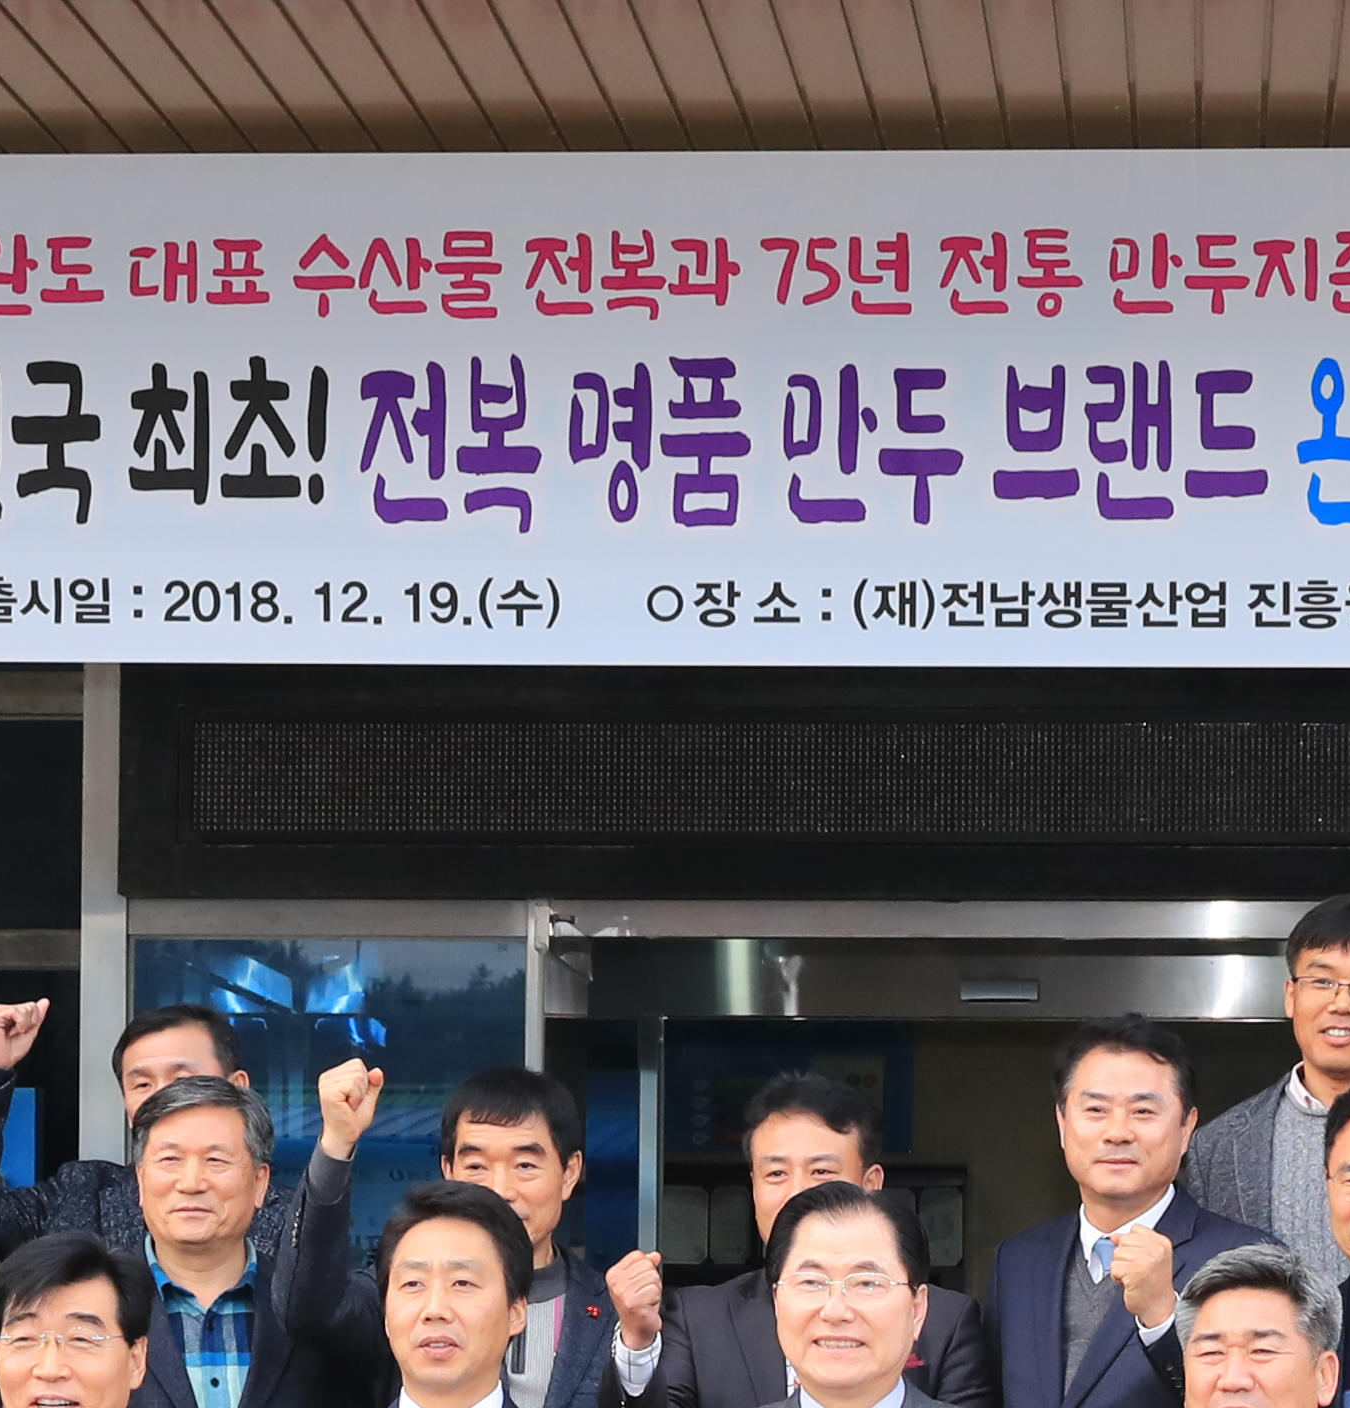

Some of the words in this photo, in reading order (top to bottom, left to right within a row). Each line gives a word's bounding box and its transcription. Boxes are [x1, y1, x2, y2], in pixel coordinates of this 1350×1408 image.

[130, 239, 270, 304] 대표
[293, 231, 502, 319] 수산물
[526, 229, 740, 320] 전복과
[760, 232, 912, 315] 75년
[940, 229, 1083, 317] 전통
[129, 356, 328, 505] 최초!
[360, 354, 542, 533] 전복
[569, 356, 751, 527] 명품
[784, 364, 963, 525] 만두
[993, 360, 1268, 520] 브랜드
[164, 581, 292, 624] 2018.
[315, 581, 382, 624] 12.
[405, 578, 559, 628] 19.(수)
[854, 579, 1226, 629] (재)전남생물산업
